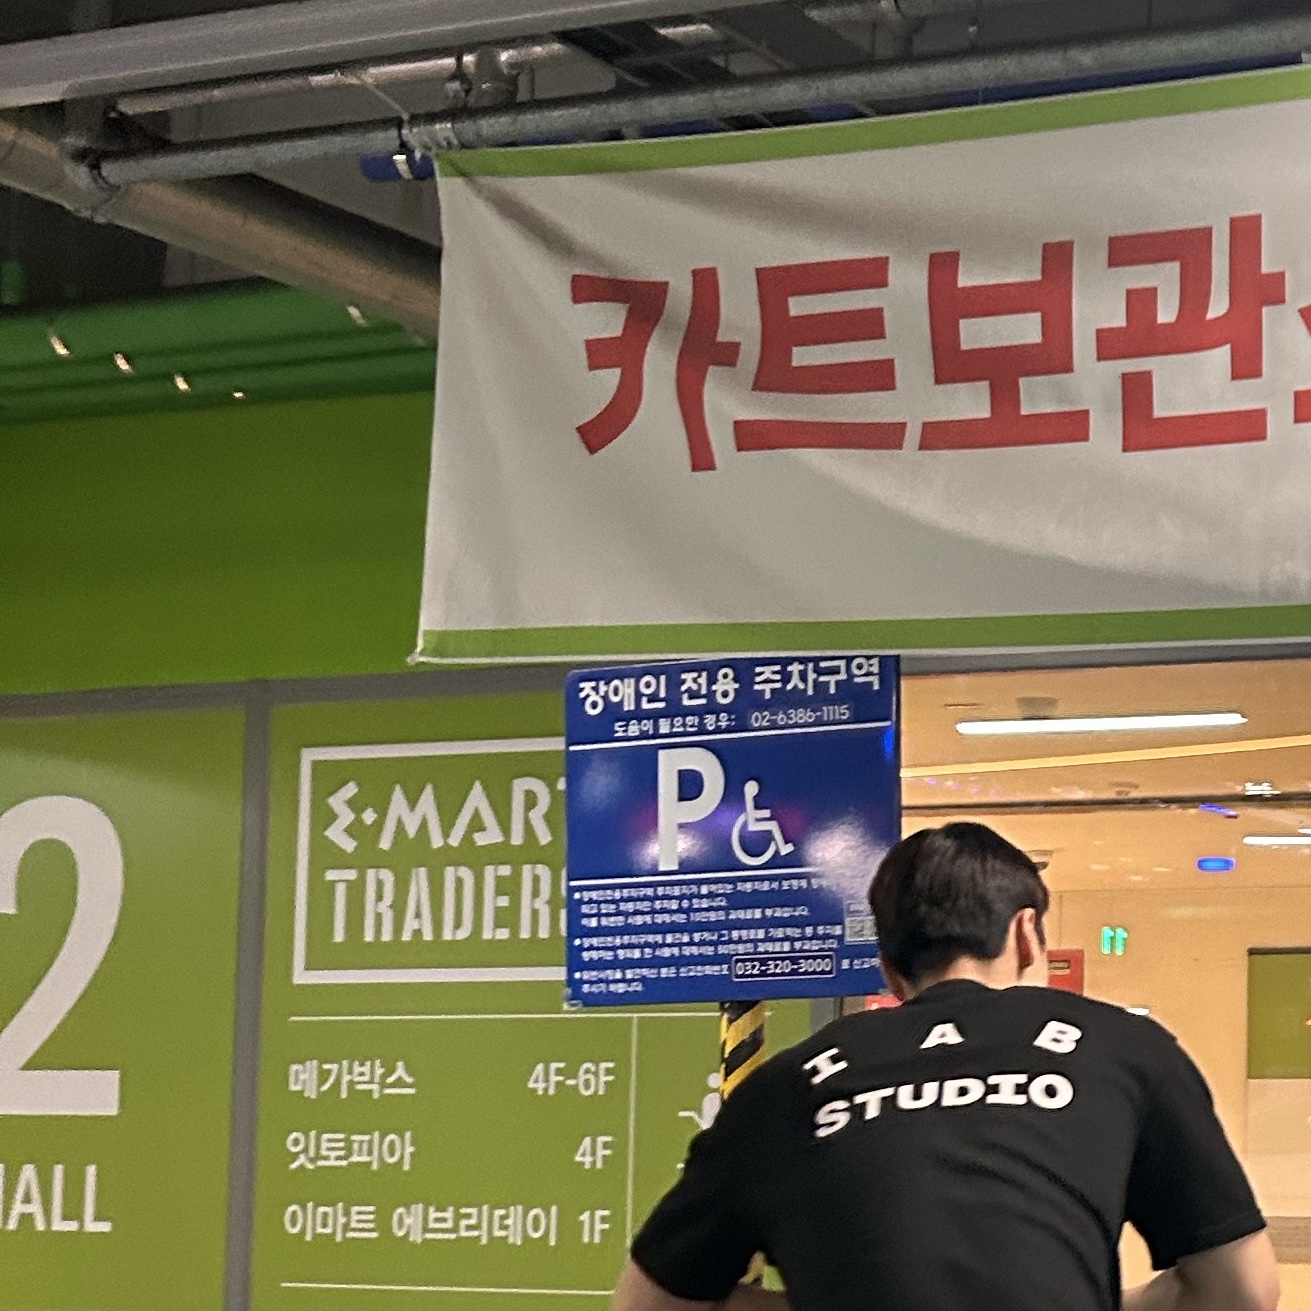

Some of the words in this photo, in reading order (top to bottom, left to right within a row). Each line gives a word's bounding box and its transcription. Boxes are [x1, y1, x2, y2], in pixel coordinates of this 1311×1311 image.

[579, 675, 666, 715] 장애인
[680, 667, 739, 706] 전용
[754, 657, 880, 699] 주차구역
[614, 719, 654, 737] 도움이
[659, 715, 699, 733] 필요한
[751, 705, 849, 727] 02-6386-1115
[658, 747, 725, 871] P
[325, 864, 566, 942] TRADER
[736, 959, 832, 975] 032-320-3000
[288, 1059, 416, 1099] 메가박스
[527, 1062, 616, 1096] 4F-6F
[814, 1073, 1074, 1138] STUDIO
[286, 1130, 416, 1171] 잇토피아
[574, 1136, 613, 1169] 4F
[0, 1163, 112, 1232] ALL
[284, 1202, 379, 1242] 이마트
[392, 1203, 558, 1246] 에브리데이
[579, 1210, 611, 1243] 1F
